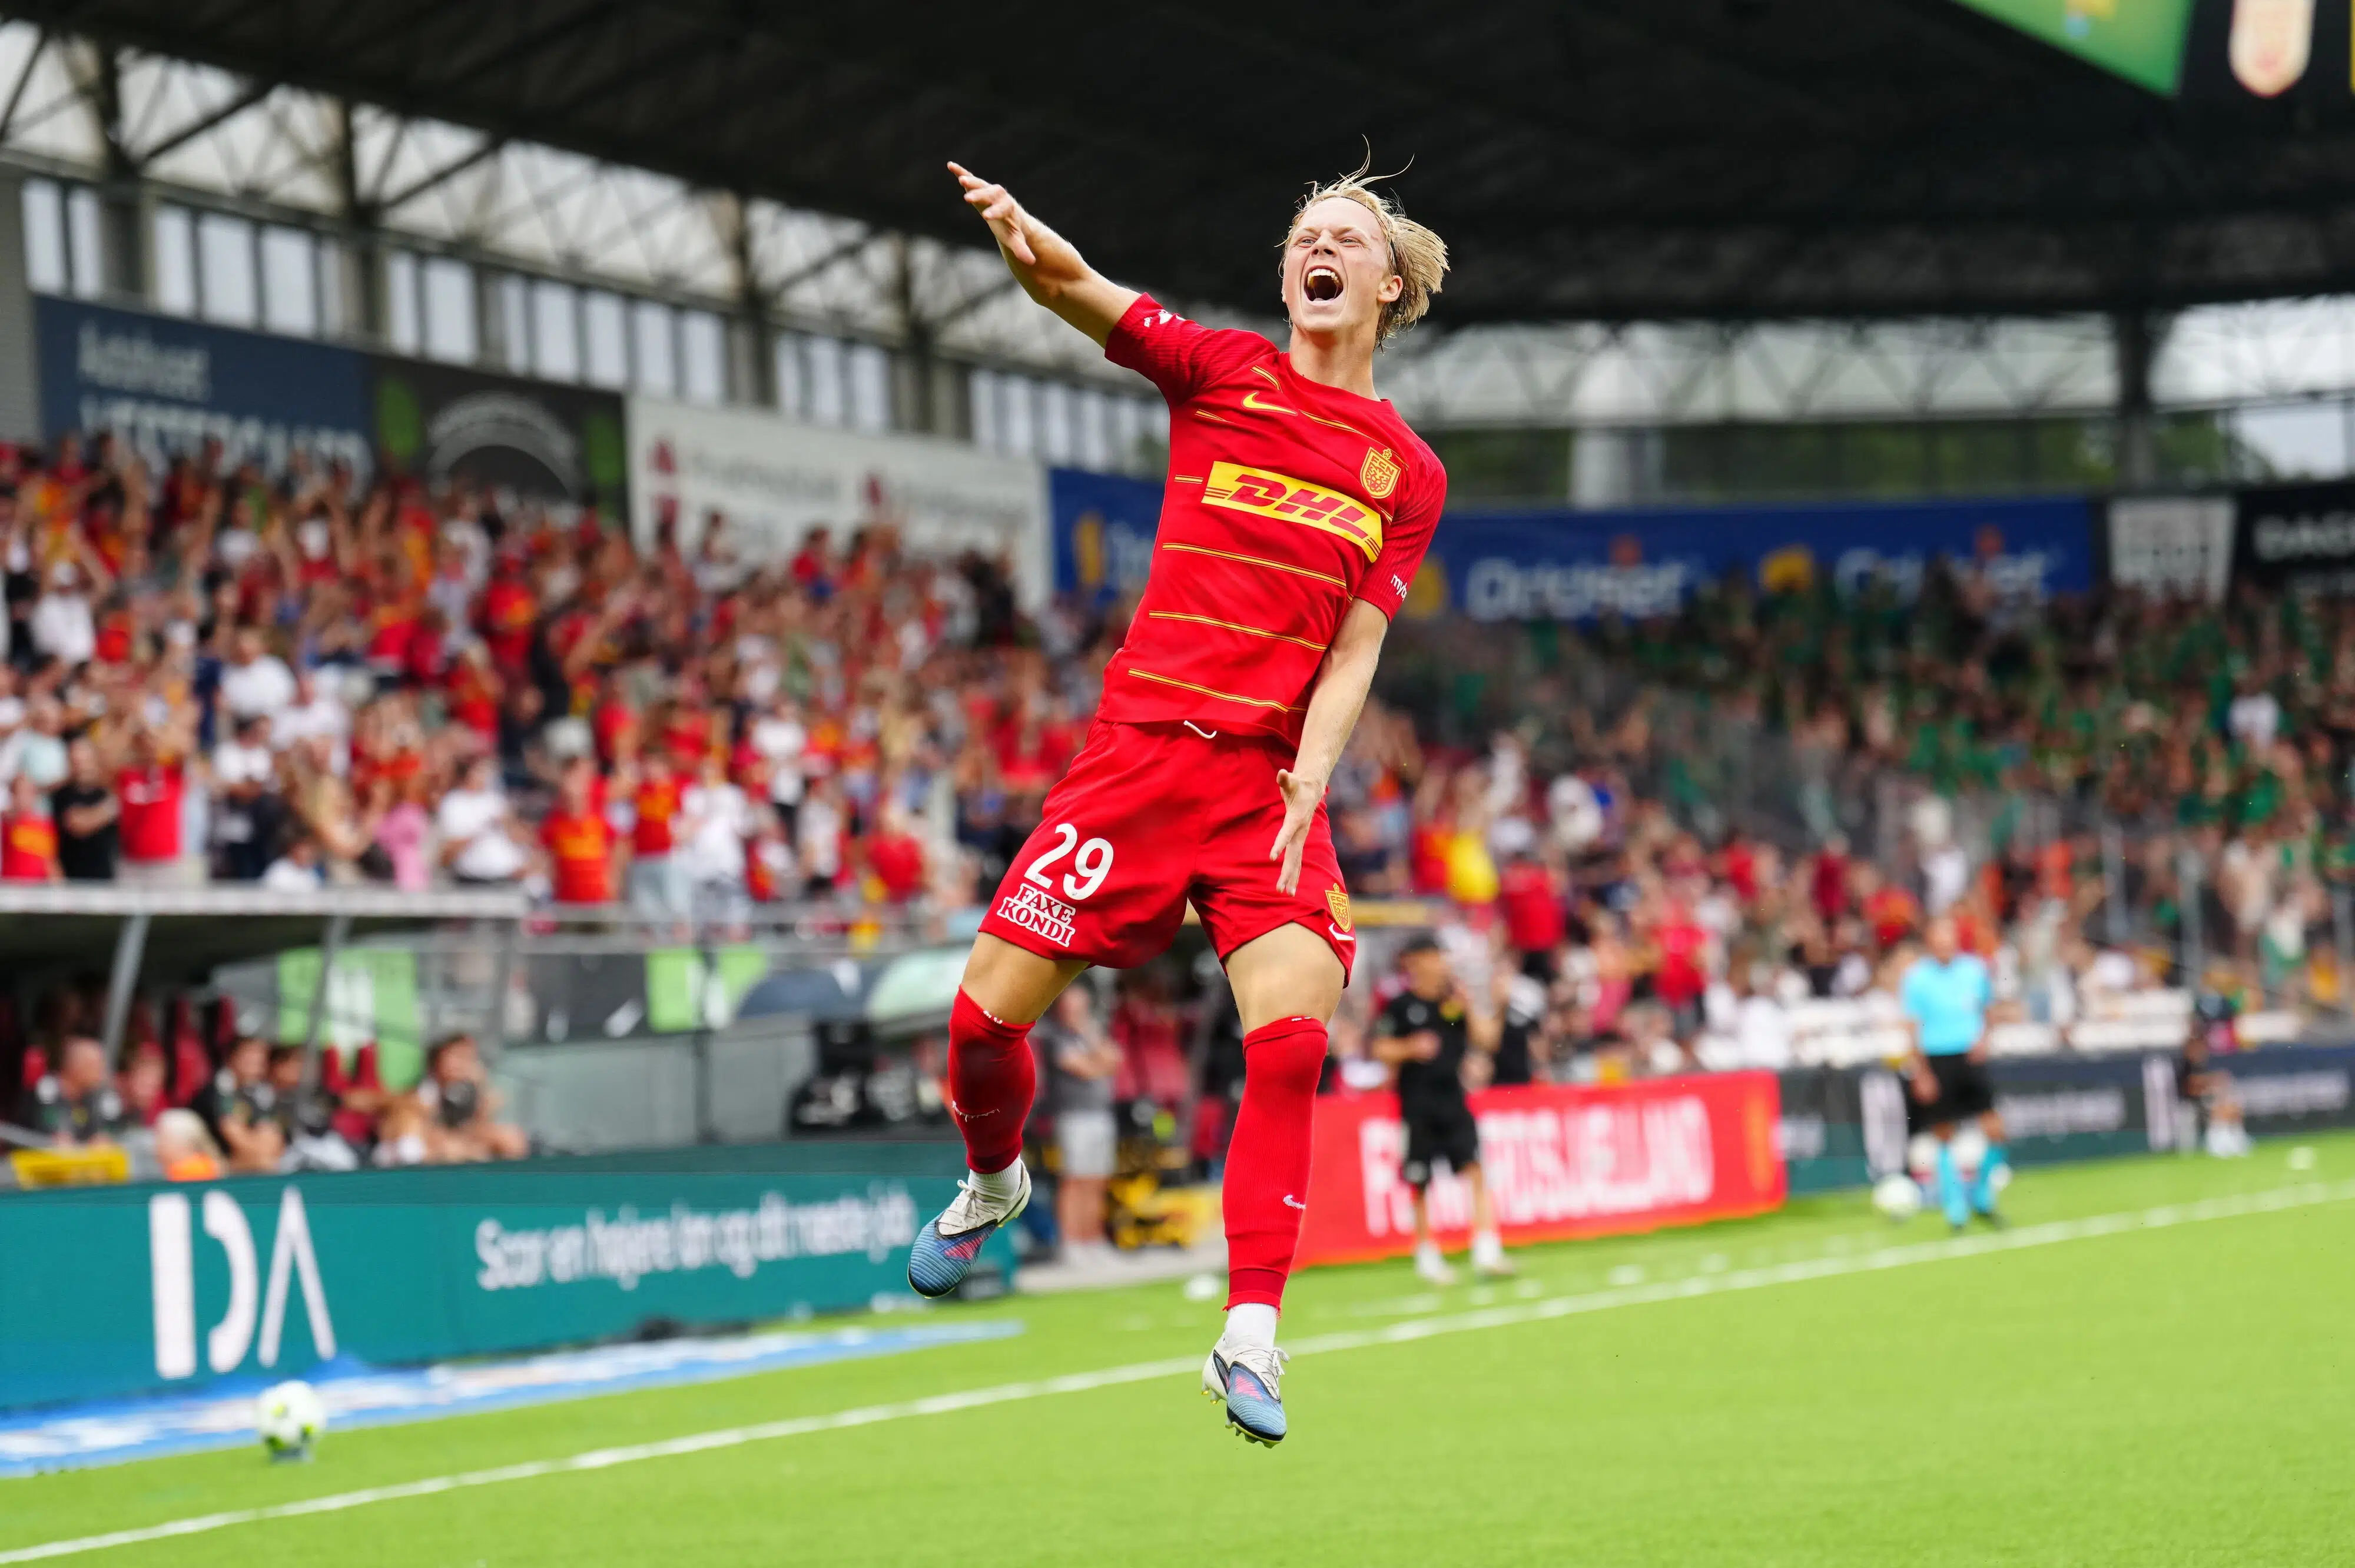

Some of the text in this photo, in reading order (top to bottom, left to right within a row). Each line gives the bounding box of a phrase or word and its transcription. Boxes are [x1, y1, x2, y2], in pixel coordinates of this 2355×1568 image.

[1371, 455, 1395, 475] FCN
[1227, 473, 1369, 539] DHL
[1023, 823, 1114, 901] 29
[997, 896, 1076, 948] KONDI
[1016, 883, 1076, 926] FAXE
[1331, 895, 1346, 905] FCN
[148, 1184, 337, 1380] IDA
